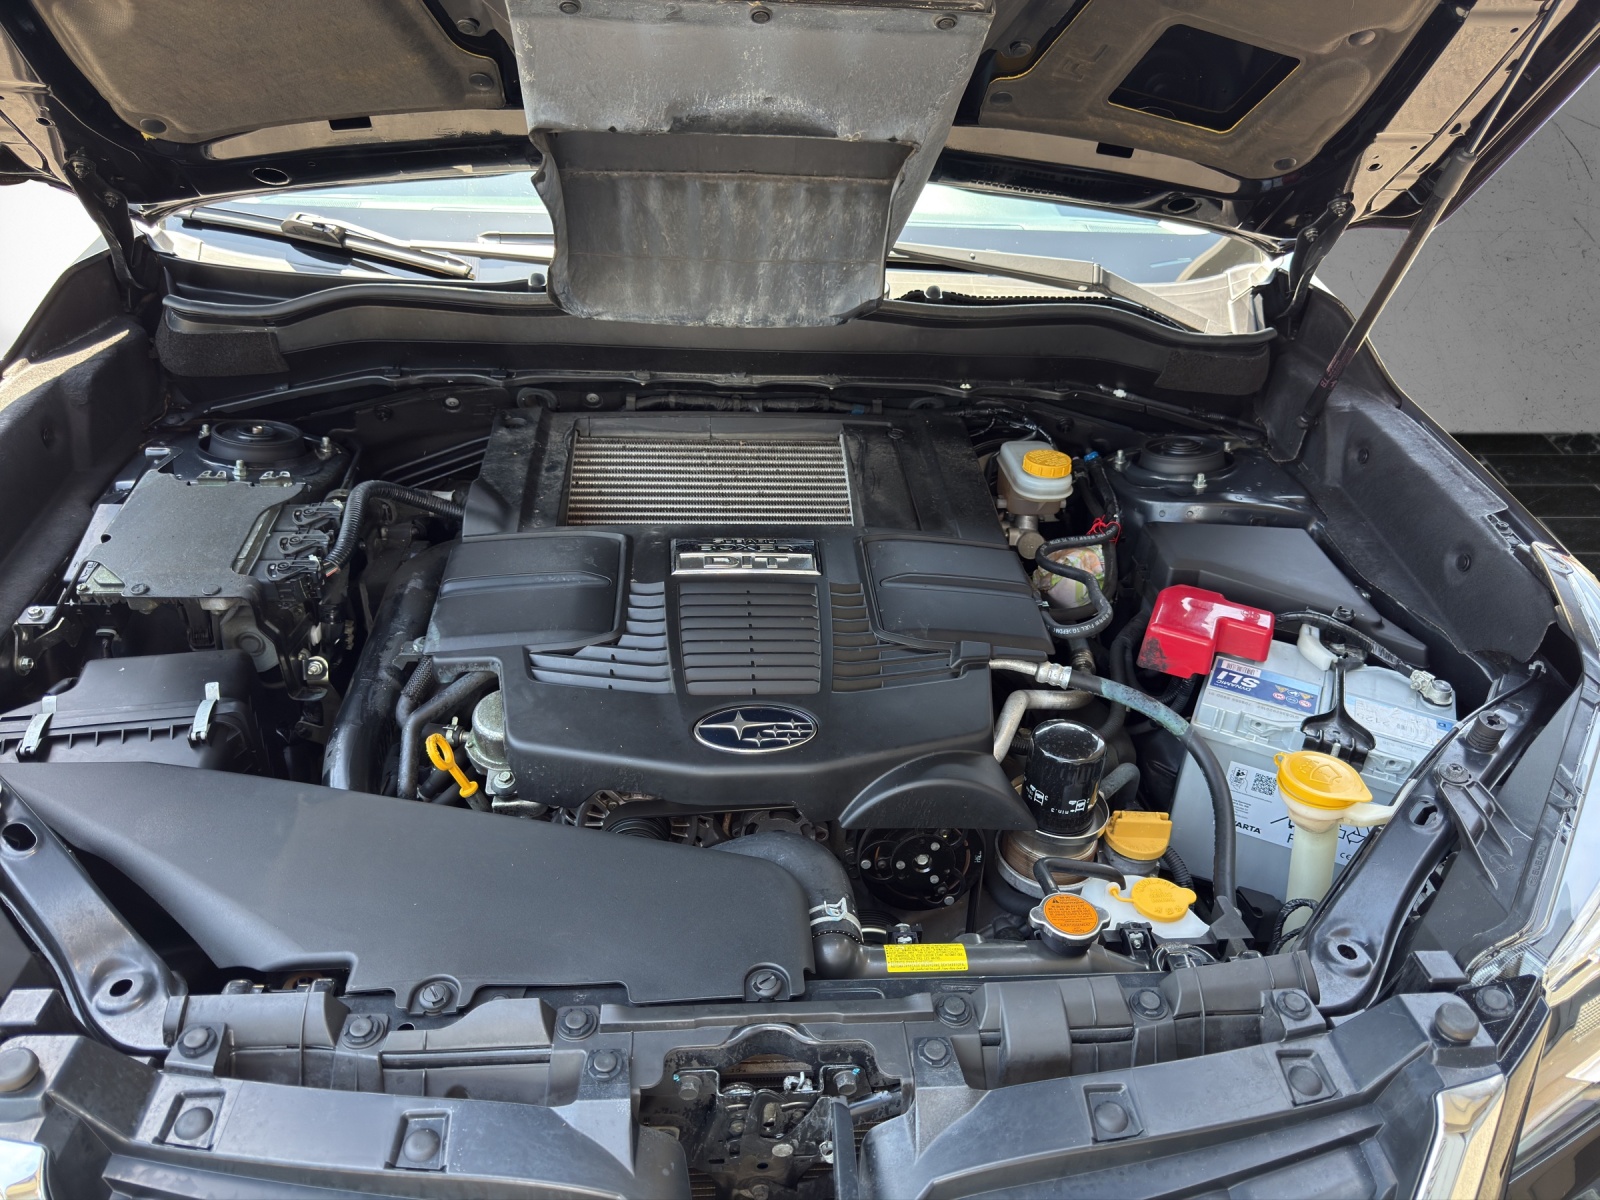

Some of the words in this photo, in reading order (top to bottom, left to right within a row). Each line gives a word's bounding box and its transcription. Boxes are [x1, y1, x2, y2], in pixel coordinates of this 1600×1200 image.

[703, 555, 789, 569] DIT
[1216, 679, 1252, 692] DYNAMIC
[1217, 671, 1261, 689] SLI
[1235, 821, 1261, 835] ARTA
[1532, 845, 1547, 876] SUBARU
